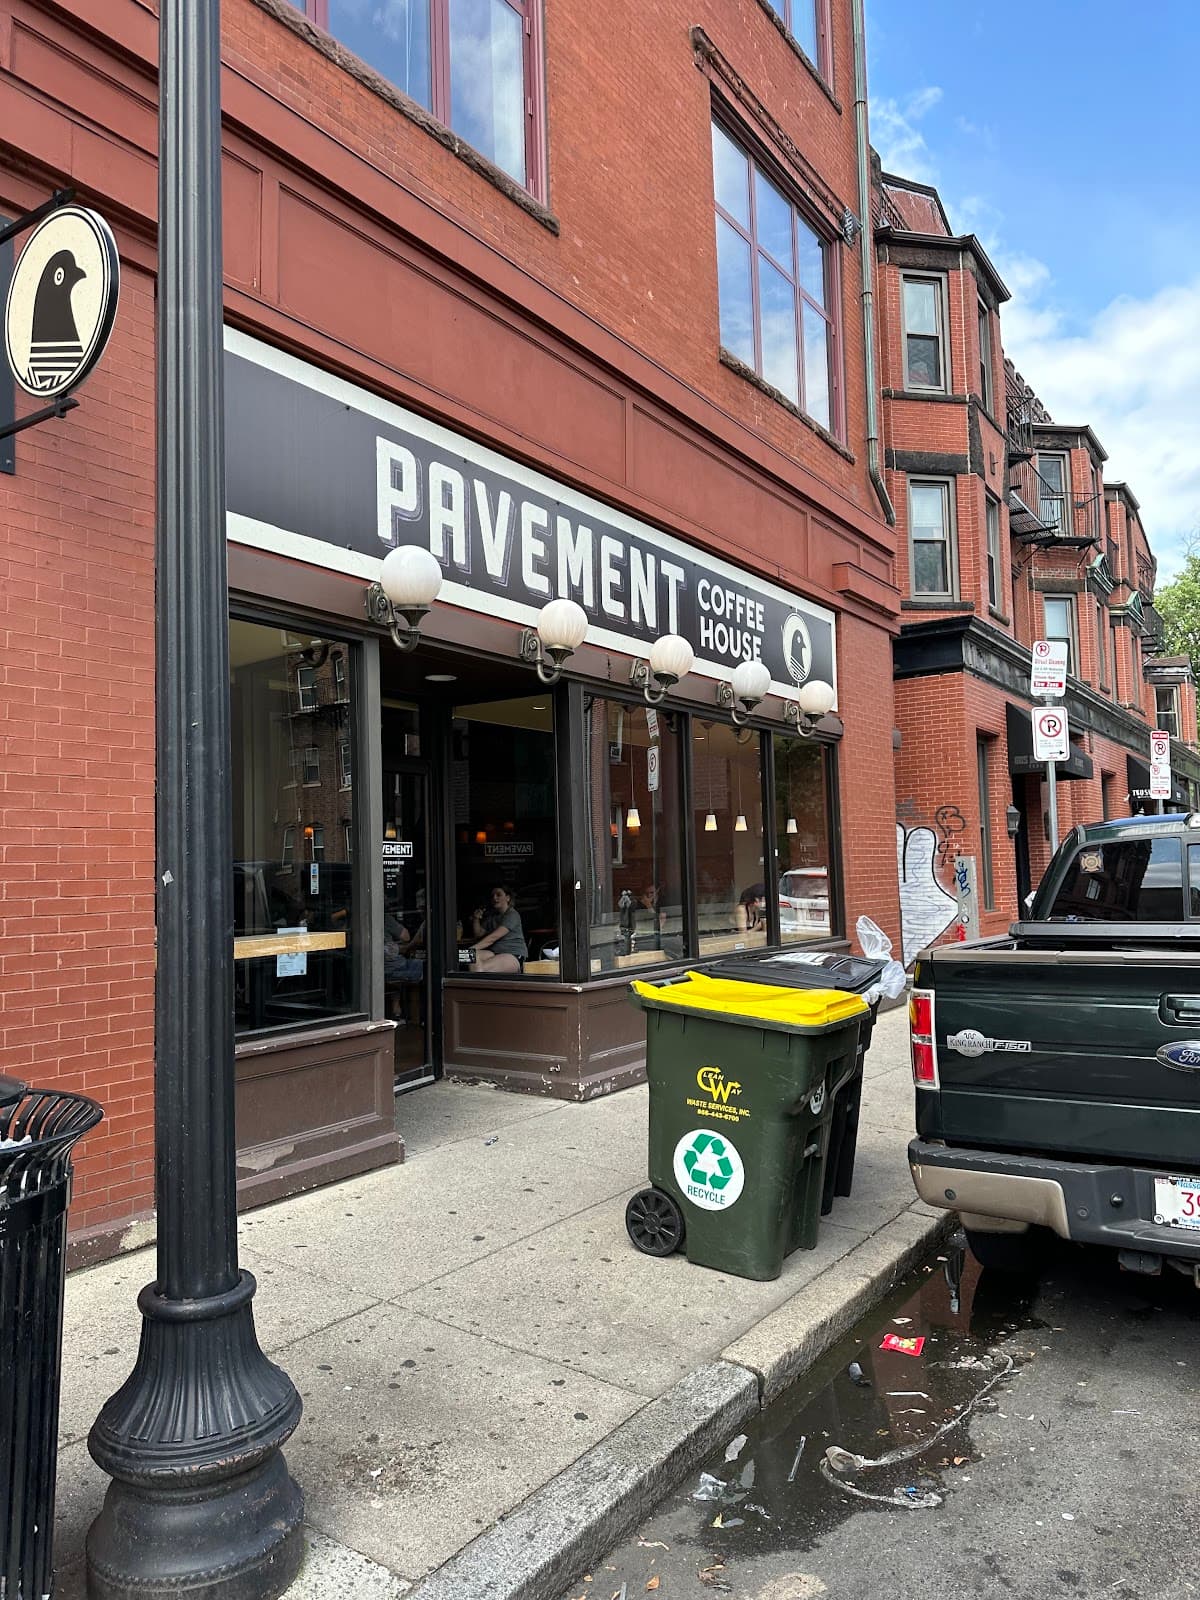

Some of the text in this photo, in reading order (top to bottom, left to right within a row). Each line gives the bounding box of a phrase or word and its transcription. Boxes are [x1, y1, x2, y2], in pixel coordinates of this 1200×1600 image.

[376, 436, 685, 635] PAVEMENT
[697, 579, 765, 632] COFFEE
[700, 615, 762, 662] HOUSE
[949, 1038, 991, 1049] KING RANCH
[994, 1042, 1028, 1050] F-150
[686, 1097, 708, 1109] WASTE
[687, 1185, 726, 1205] RECYCLE
[1181, 1191, 1200, 1217] 3
